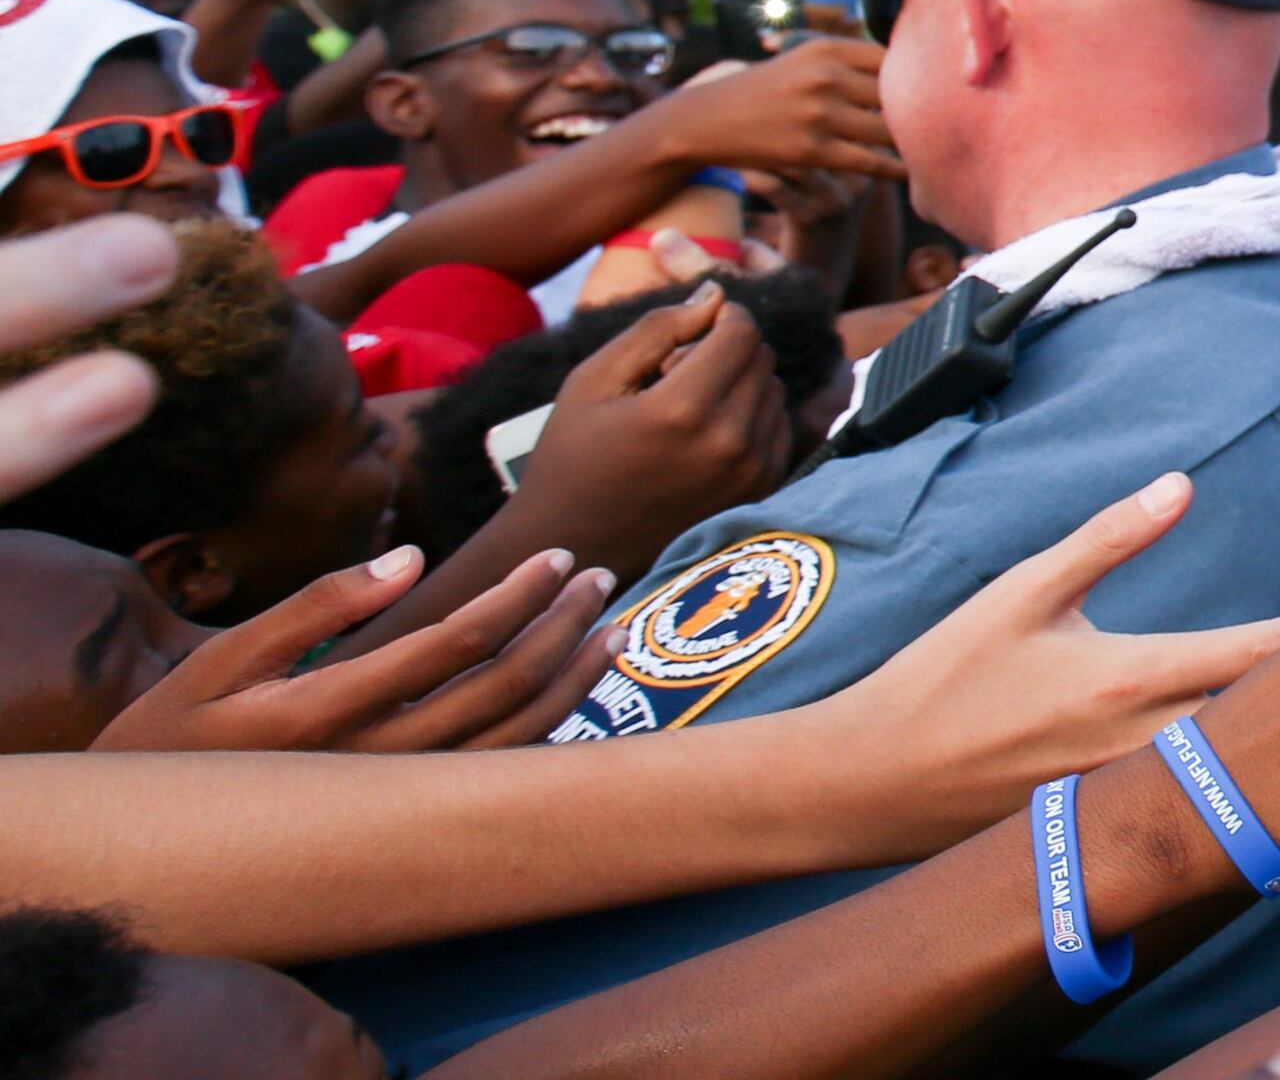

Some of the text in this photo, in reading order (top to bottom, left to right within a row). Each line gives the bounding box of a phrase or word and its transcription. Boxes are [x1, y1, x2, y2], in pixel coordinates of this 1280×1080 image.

[1045, 794, 1064, 819] ON
[1045, 819, 1067, 858] OUR
[1049, 857, 1071, 907] TEAM
